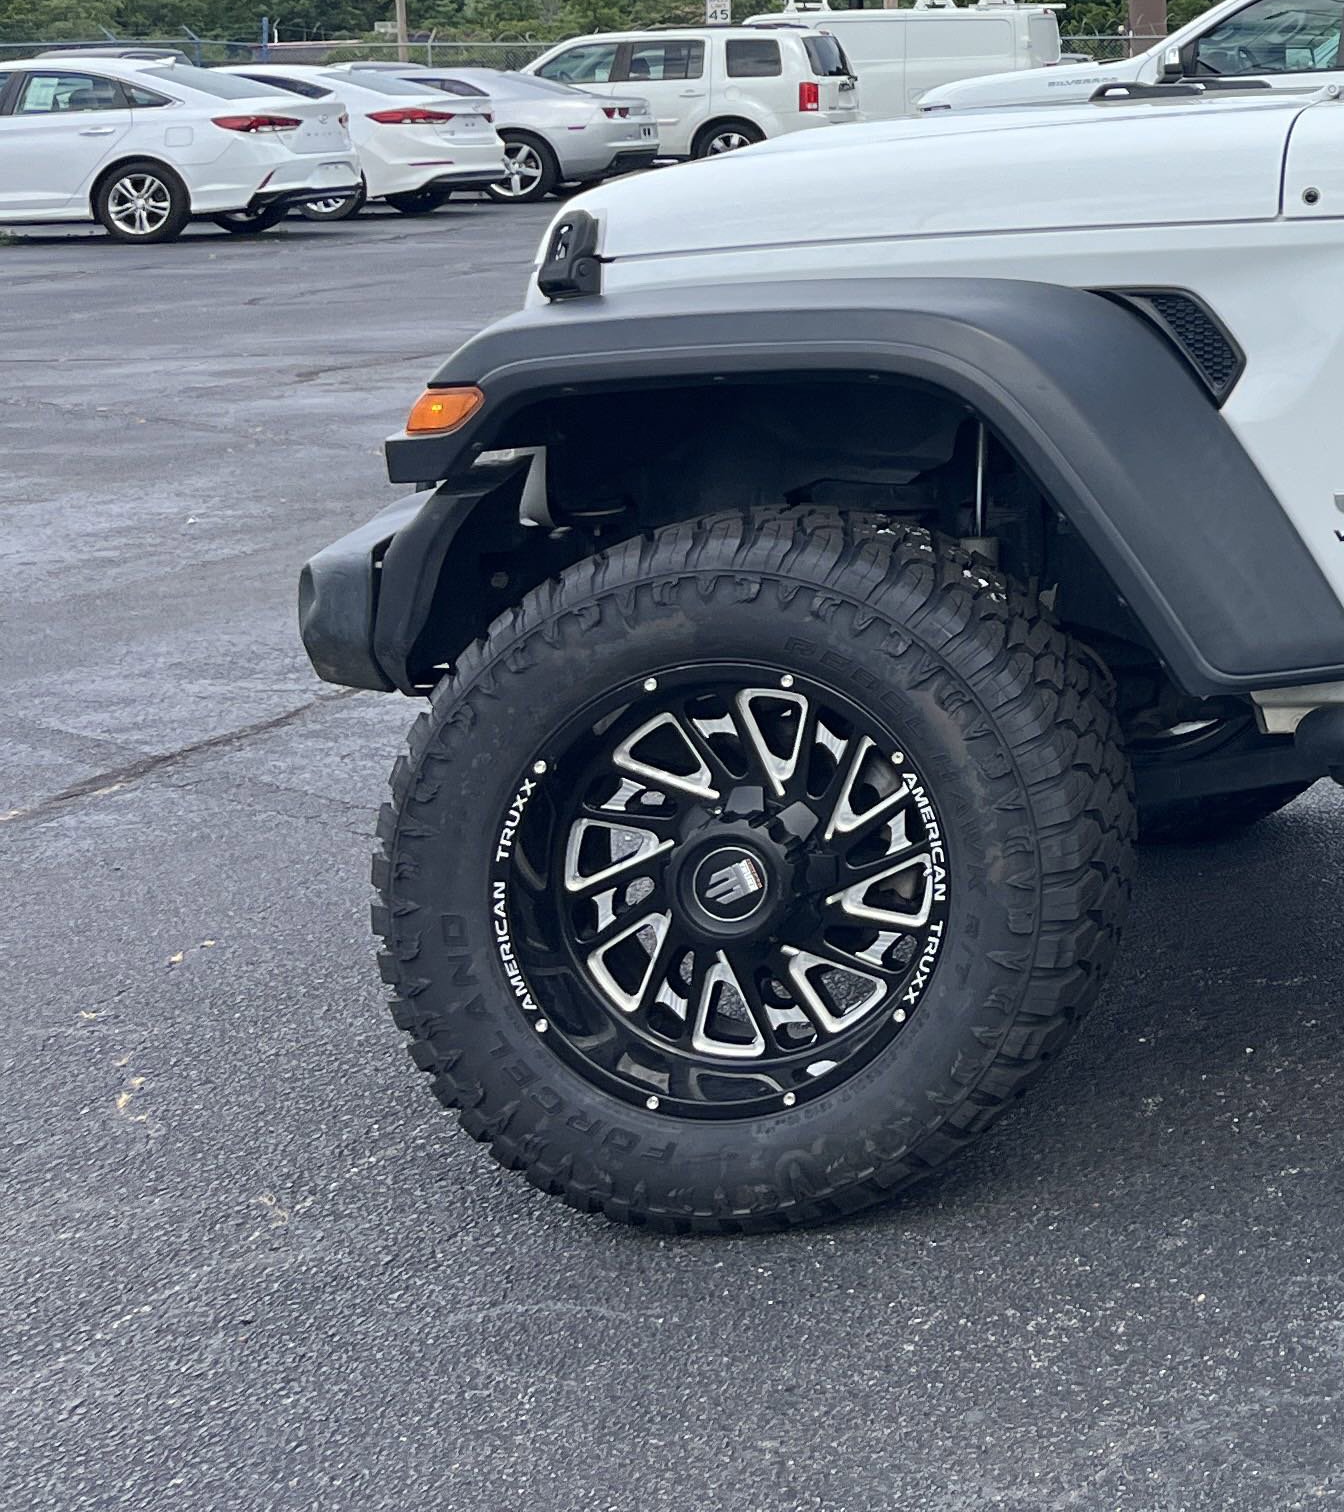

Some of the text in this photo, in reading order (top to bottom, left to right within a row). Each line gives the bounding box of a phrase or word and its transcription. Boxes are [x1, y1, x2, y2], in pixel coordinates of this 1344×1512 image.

[708, 9, 729, 20] 45
[493, 778, 538, 1012] AMERICAN TRUXX
[901, 771, 947, 1005] AMERICAN TRUXX
